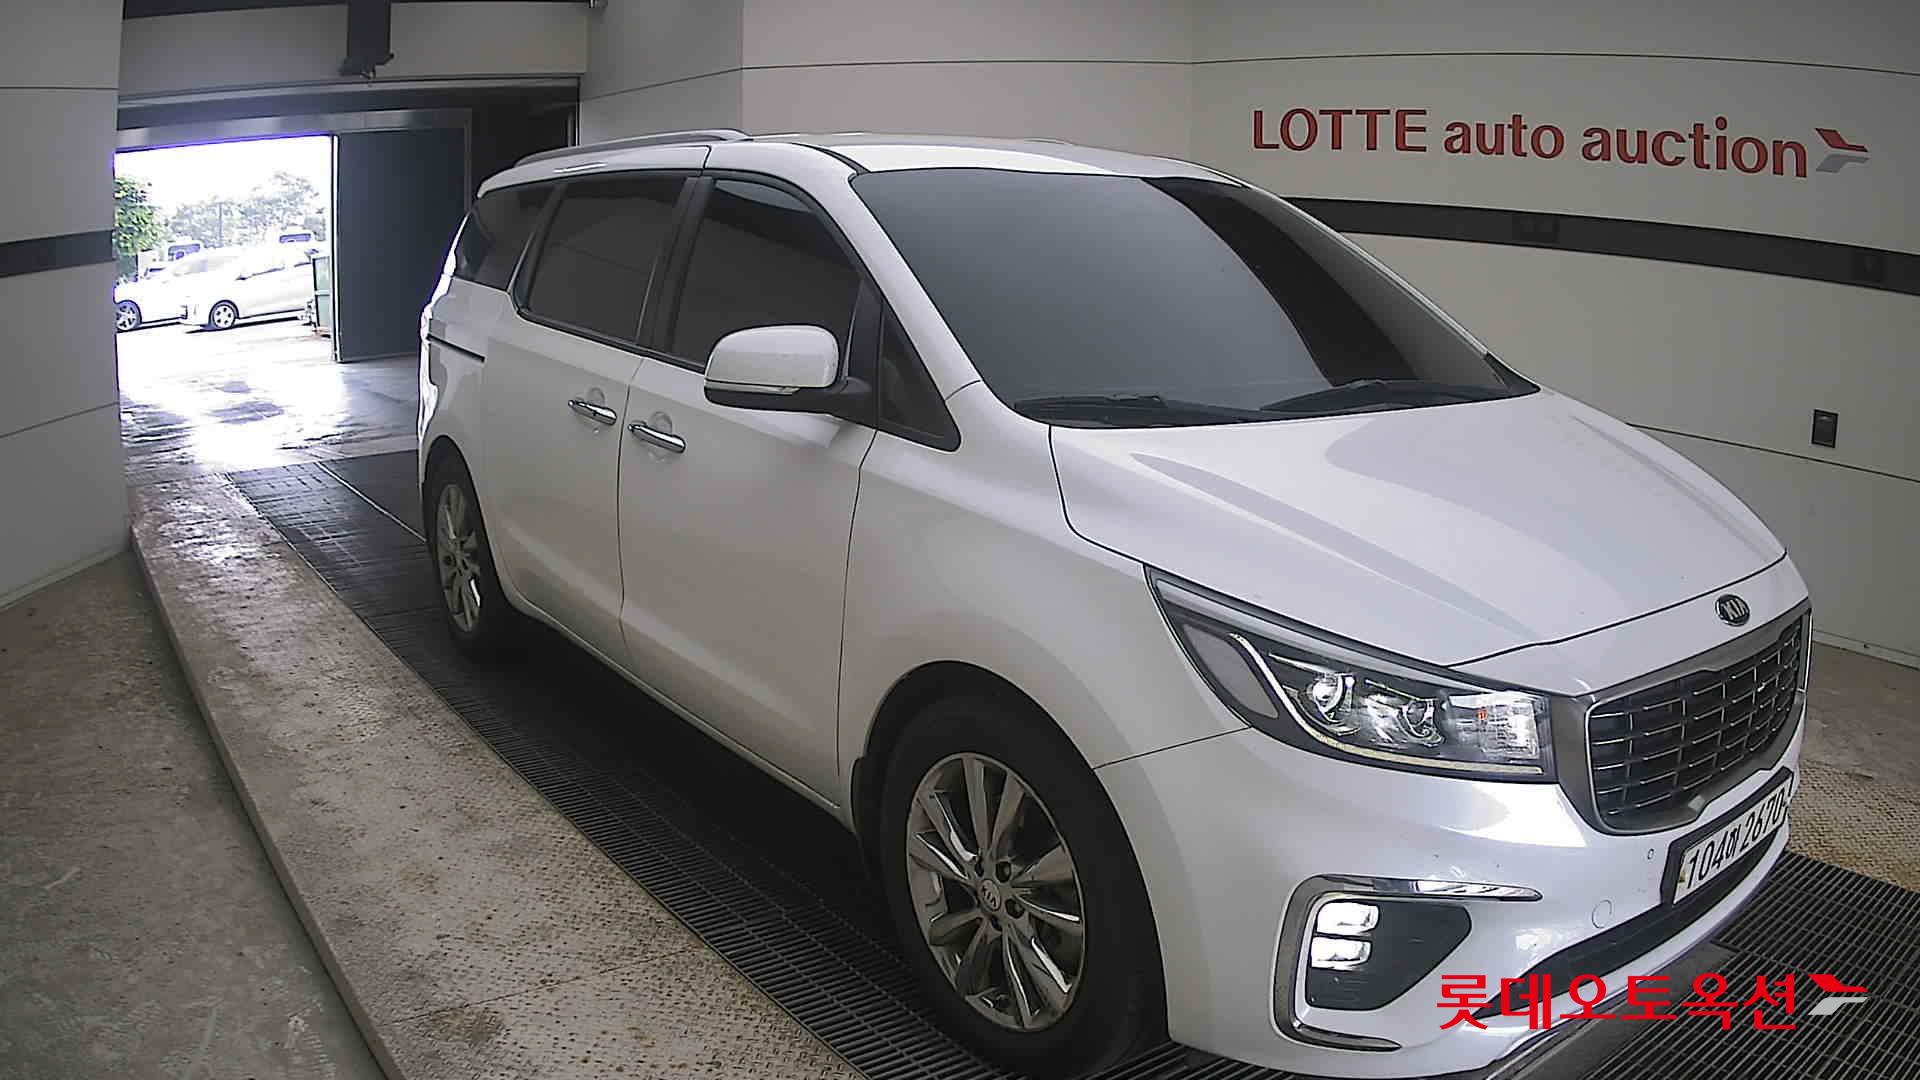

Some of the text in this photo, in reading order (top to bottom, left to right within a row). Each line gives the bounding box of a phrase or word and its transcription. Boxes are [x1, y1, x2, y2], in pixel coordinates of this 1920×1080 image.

[1253, 108, 1808, 178] LOTTE auto auction
[1720, 598, 1749, 621] KIA
